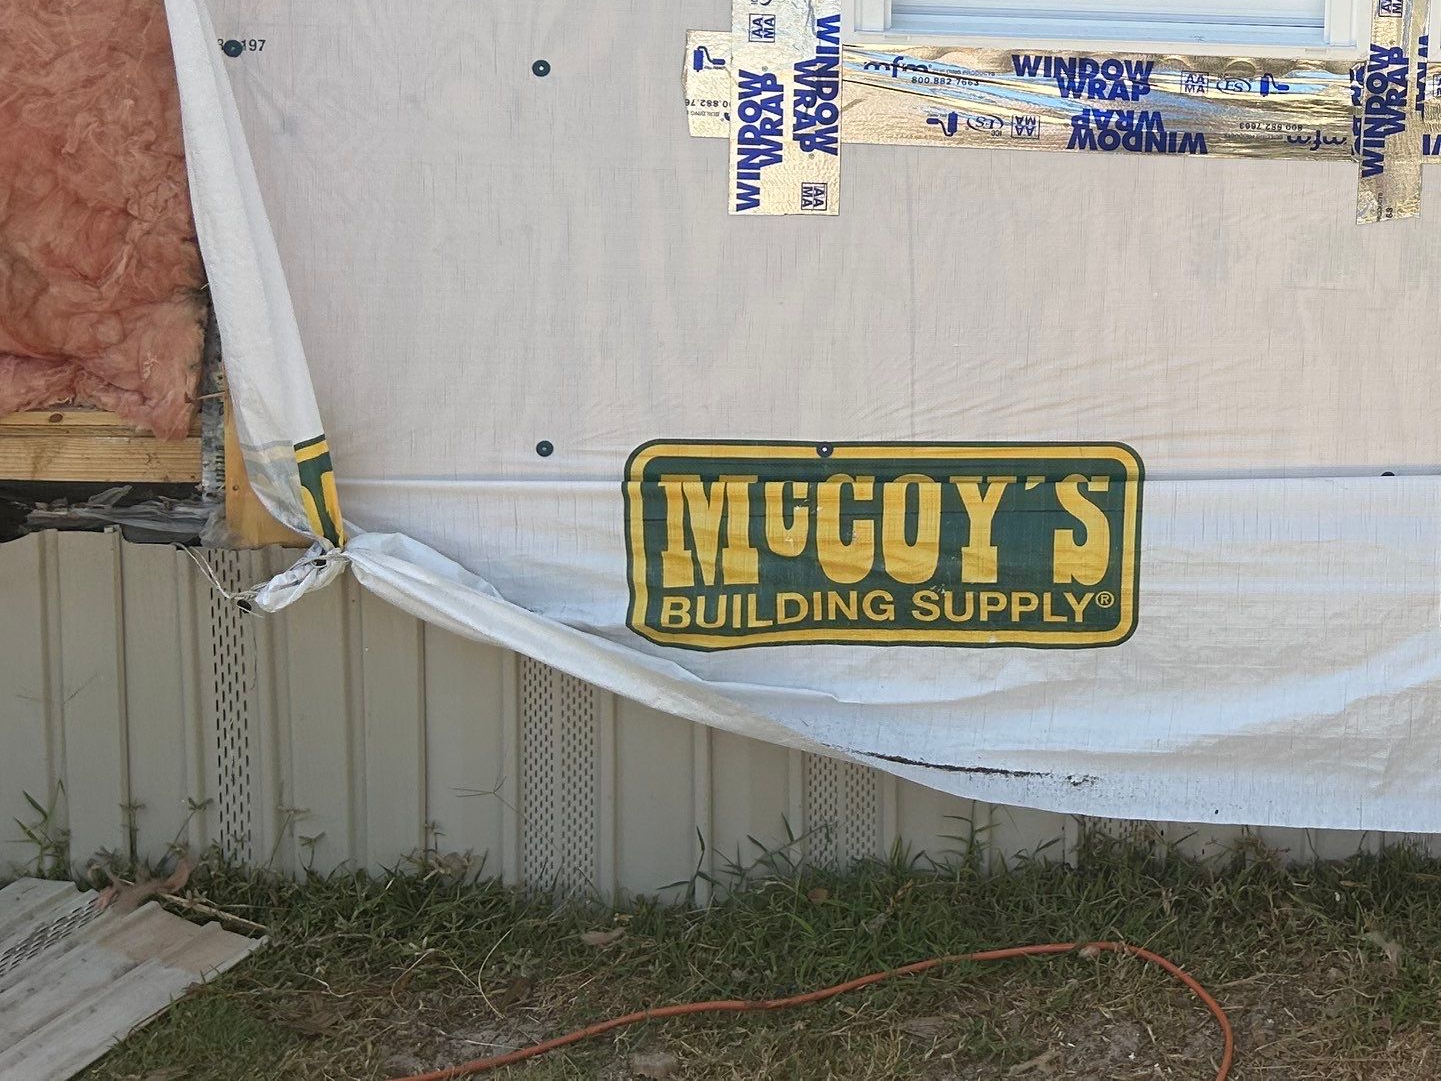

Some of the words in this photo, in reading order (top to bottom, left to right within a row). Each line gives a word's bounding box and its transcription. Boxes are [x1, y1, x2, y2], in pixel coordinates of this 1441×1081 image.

[751, 16, 763, 39] AA
[763, 16, 775, 40] MA
[863, 56, 929, 78] mfm
[1012, 54, 1154, 87] WINDOW
[1184, 73, 1206, 84] AA
[815, 13, 842, 157] WINDOW
[1056, 76, 1151, 102] WRAP
[1184, 84, 1206, 94] MA
[1385, 46, 1410, 136] WRAP
[689, 110, 721, 118] BUILDING
[792, 58, 818, 154] WRAP
[1361, 43, 1391, 178] WINDOW
[759, 72, 784, 169] WRAP
[1014, 125, 1034, 136] AA
[1015, 115, 1037, 125] MA
[1071, 108, 1165, 132] WRAP
[735, 68, 763, 212] WINDOW
[1066, 127, 1208, 155] WINDOW
[1286, 129, 1347, 151] mfm
[802, 185, 814, 208] MA
[813, 187, 825, 208] AA
[658, 473, 1113, 590] McCOY'S
[661, 589, 896, 630] BUILDING
